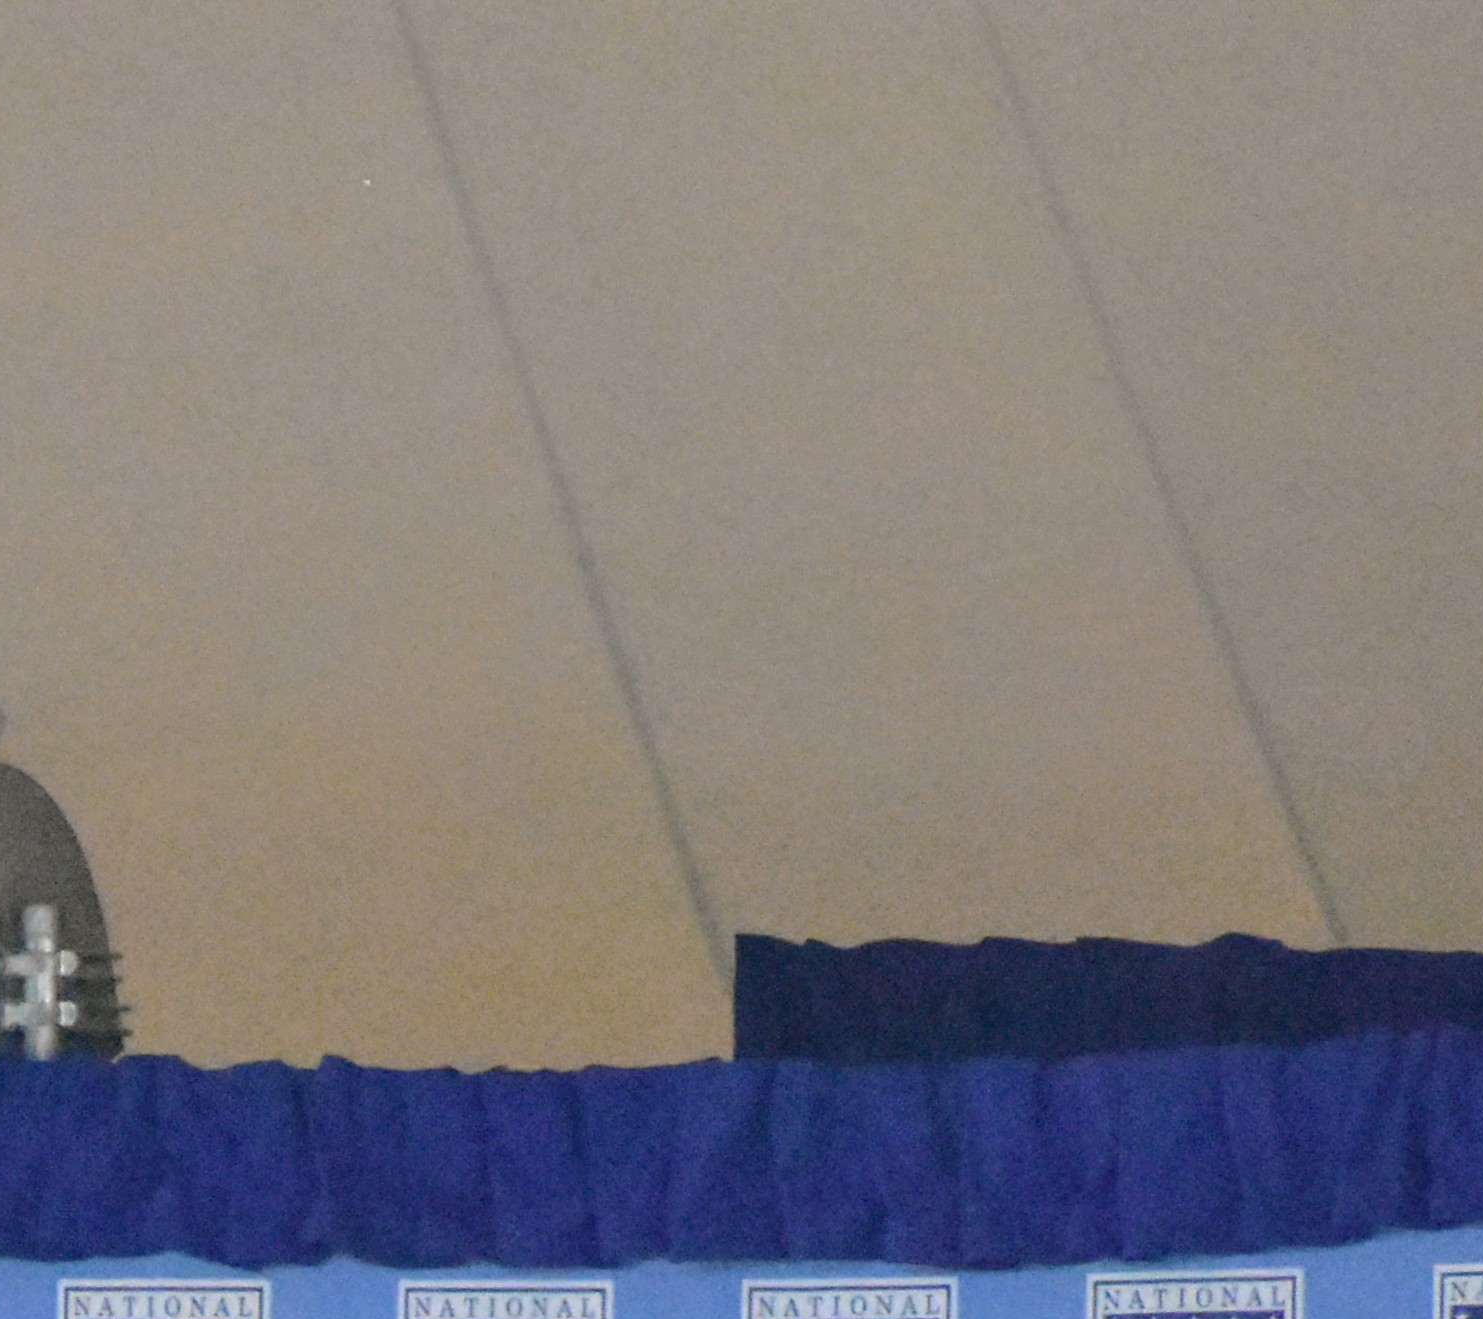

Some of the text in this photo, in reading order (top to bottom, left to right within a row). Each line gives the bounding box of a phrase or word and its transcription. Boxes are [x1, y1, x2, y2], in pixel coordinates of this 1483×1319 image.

[74, 1295, 252, 1317] NATIONAL
[415, 1297, 595, 1318] NATIONAL
[758, 1293, 940, 1318] NATIONAL
[1103, 1284, 1285, 1311] NATIONAL
